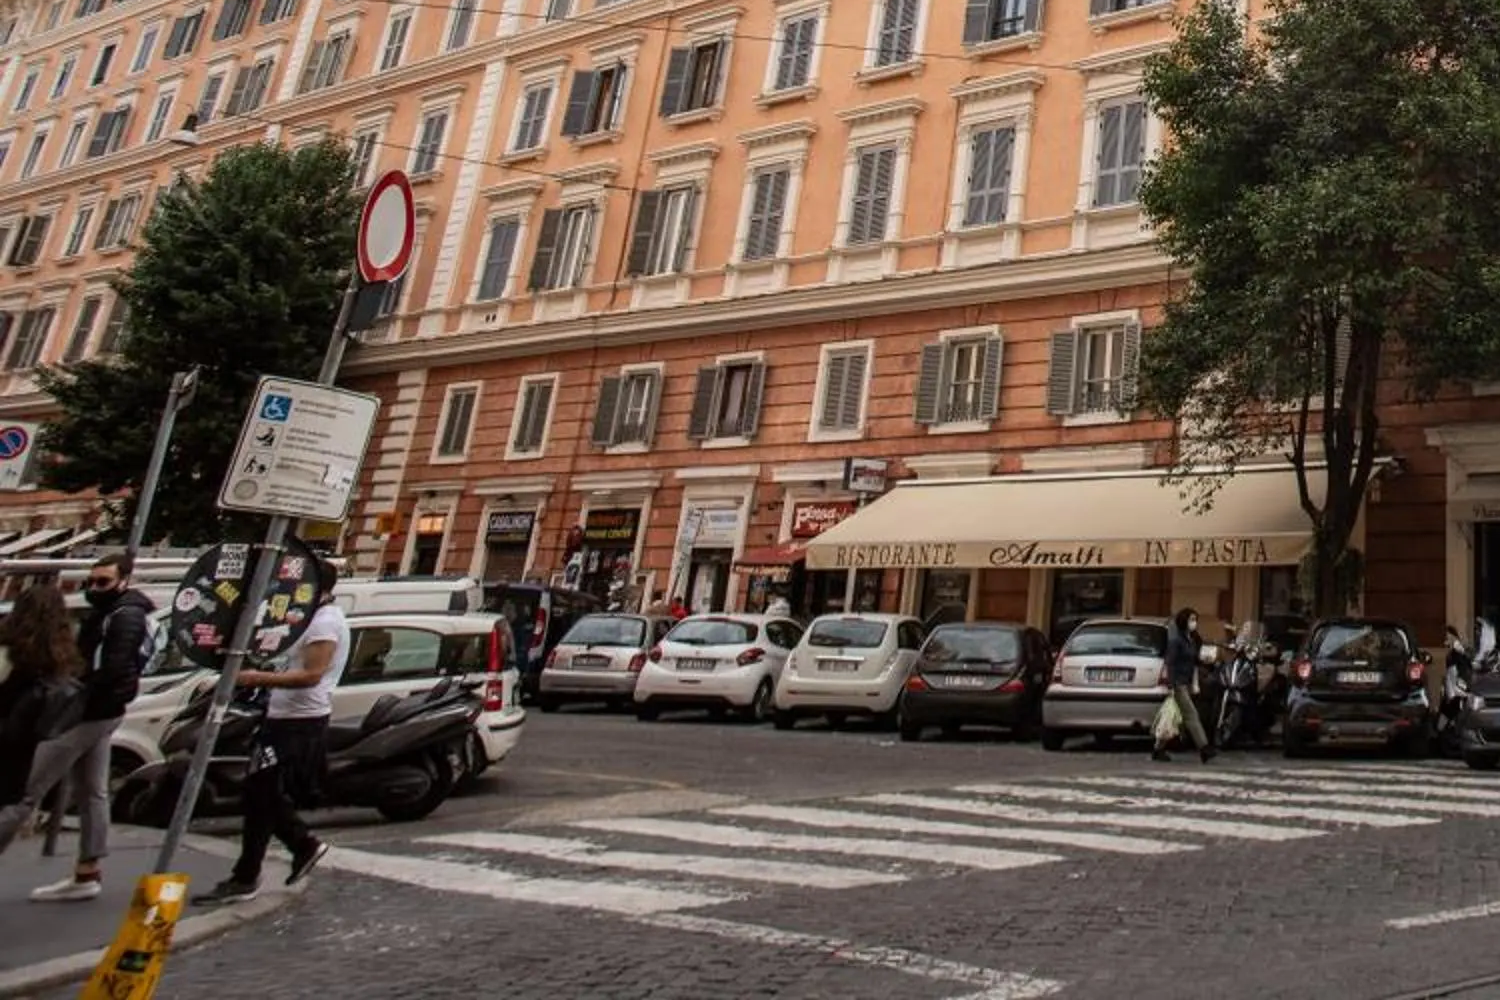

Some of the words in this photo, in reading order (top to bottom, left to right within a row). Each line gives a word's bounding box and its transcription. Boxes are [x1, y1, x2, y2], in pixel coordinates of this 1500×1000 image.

[835, 543, 957, 567] RISTORANTE
[988, 541, 1105, 567] Amalfi
[1143, 541, 1171, 564] IN
[1191, 538, 1269, 563] PASTA
